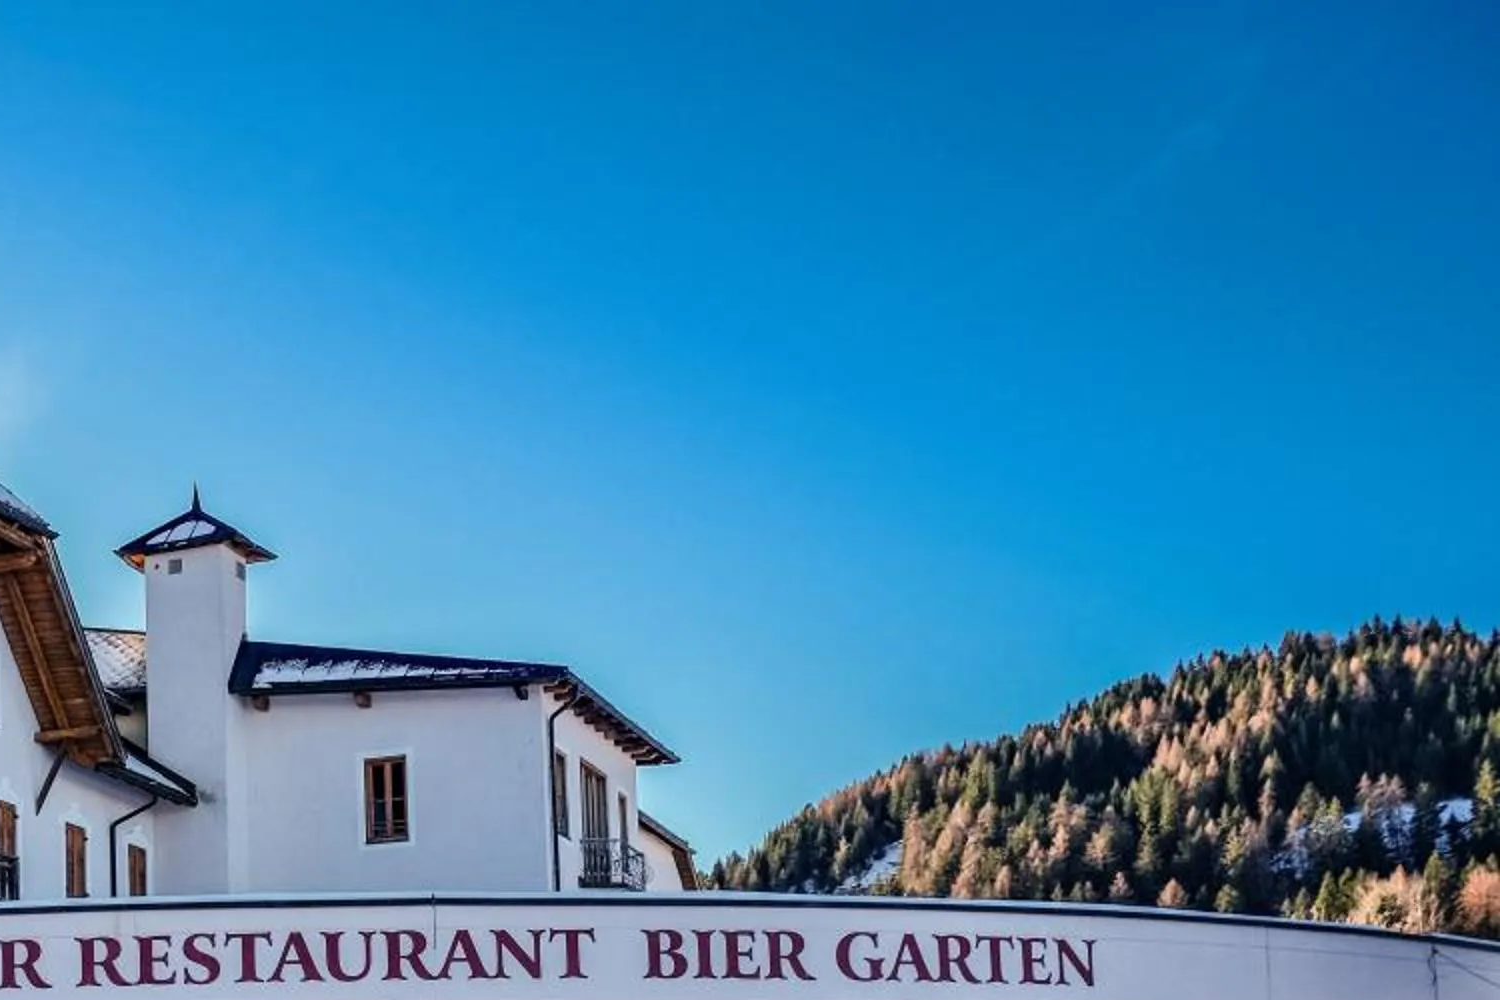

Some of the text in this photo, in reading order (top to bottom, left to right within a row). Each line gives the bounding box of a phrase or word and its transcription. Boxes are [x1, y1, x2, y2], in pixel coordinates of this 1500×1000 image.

[75, 928, 597, 988] RESTAURANT
[641, 929, 817, 981] BIER
[834, 931, 1098, 988] GARTEN
